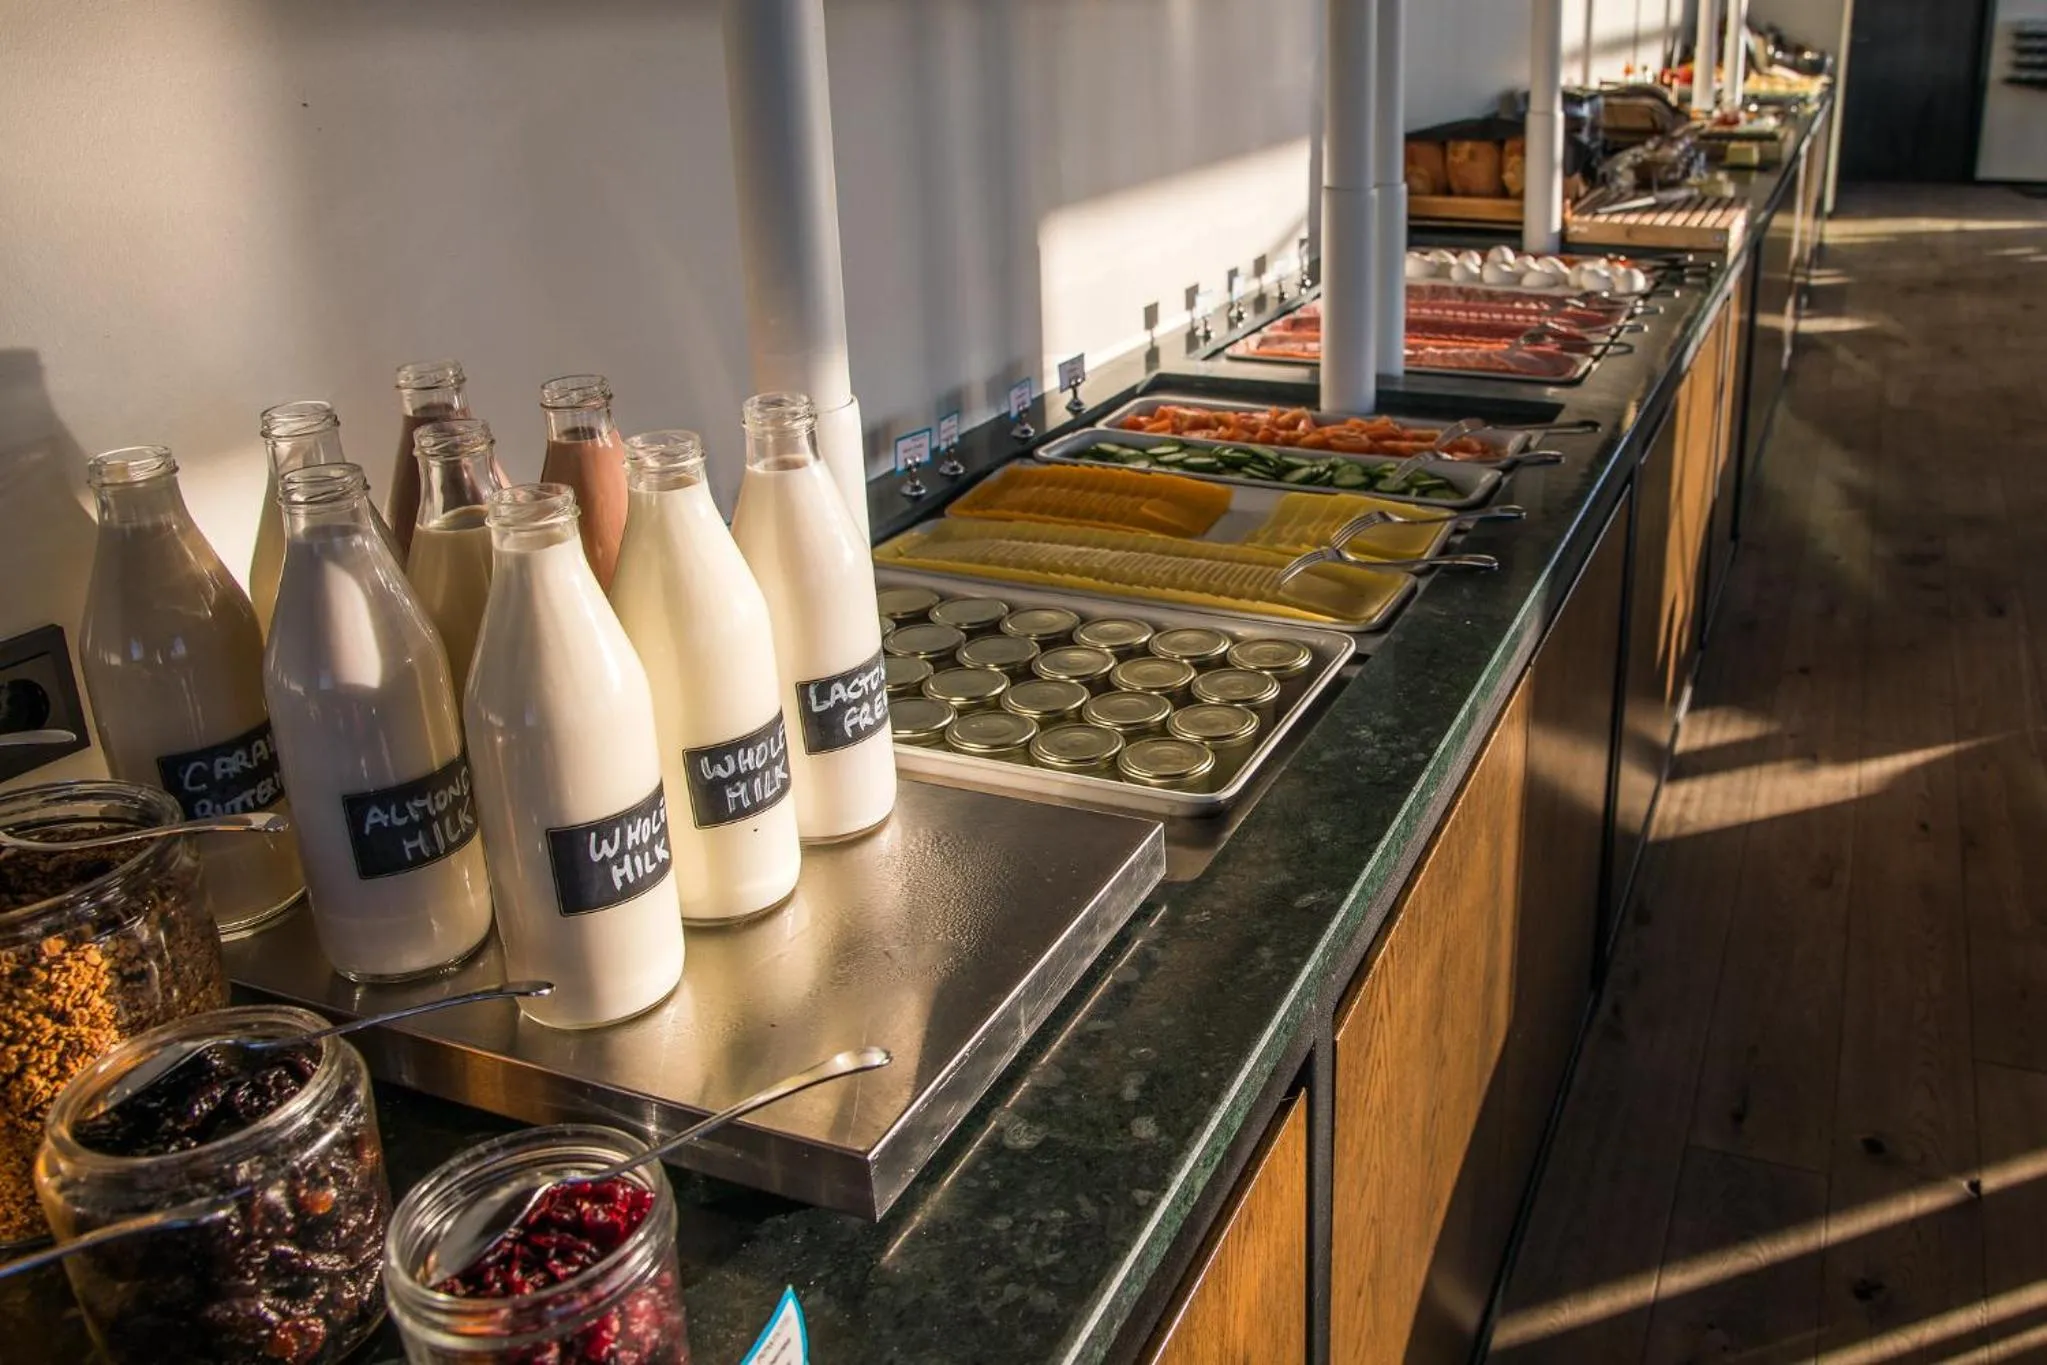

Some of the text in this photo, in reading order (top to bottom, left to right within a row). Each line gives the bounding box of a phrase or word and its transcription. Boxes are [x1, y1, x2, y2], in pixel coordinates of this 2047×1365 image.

[184, 734, 275, 791] CARA
[725, 755, 788, 813] MILK
[402, 796, 474, 860] MILK
[612, 838, 670, 891] MILK
